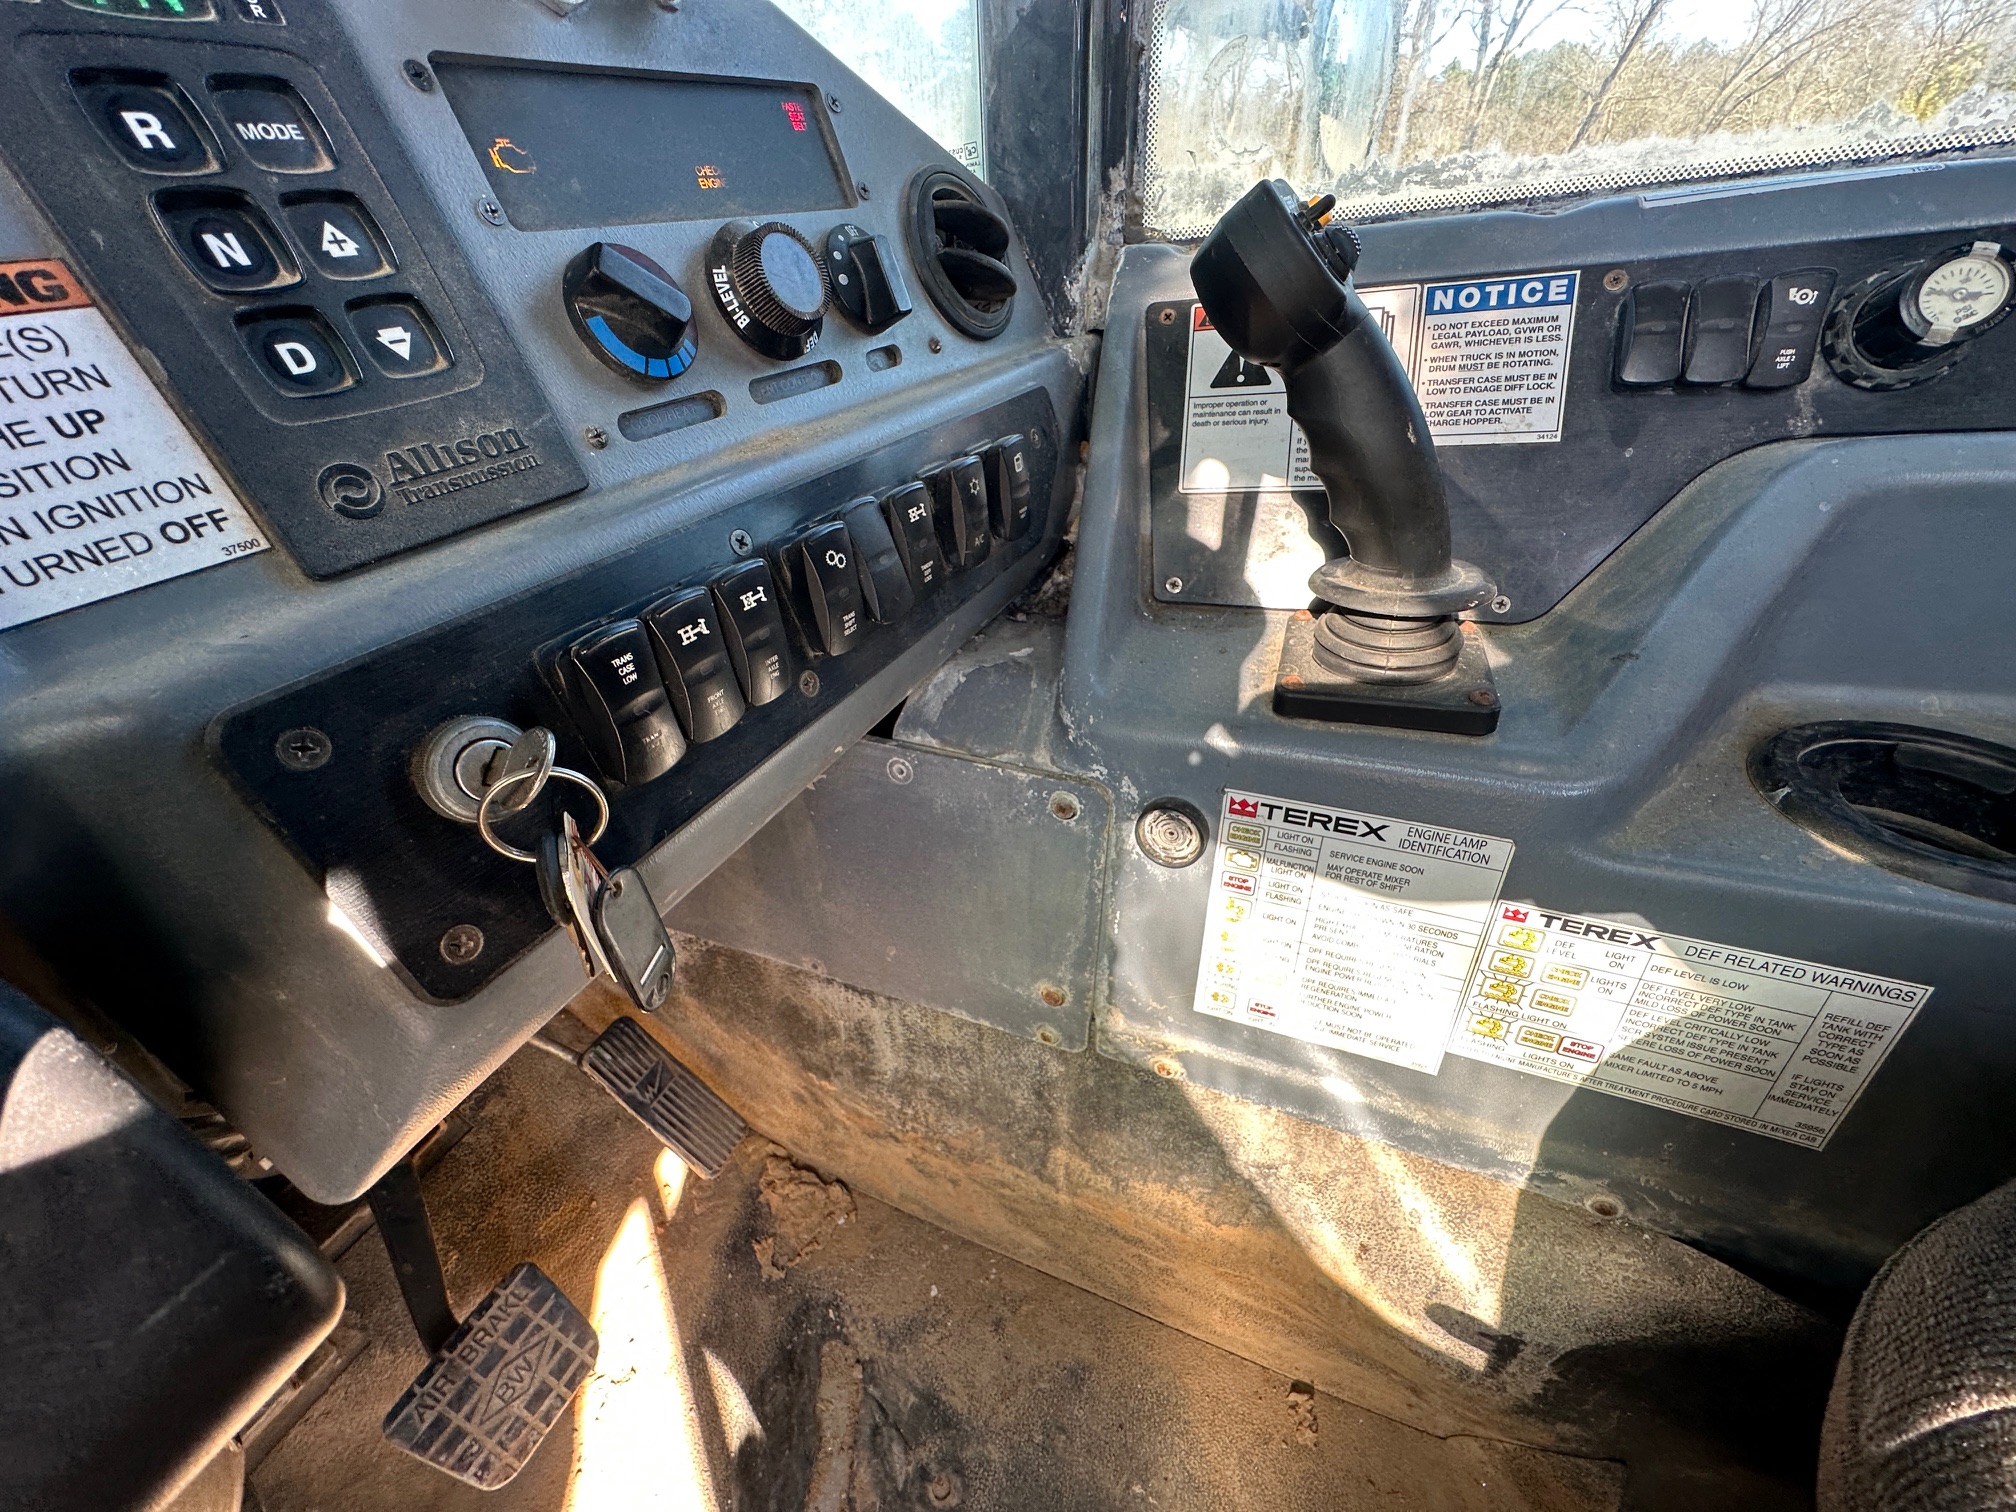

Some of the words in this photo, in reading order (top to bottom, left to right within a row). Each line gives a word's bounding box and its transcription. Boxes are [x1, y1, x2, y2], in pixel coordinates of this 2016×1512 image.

[120, 111, 176, 149] R
[236, 123, 305, 140] MODE
[201, 231, 254, 268] N
[712, 264, 751, 329] BI-LEVEL
[1433, 279, 1569, 311] NOTICE
[1433, 323, 1446, 331] DO
[1449, 322, 1469, 330] NOT
[1471, 319, 1509, 328] EXCEED
[1512, 315, 1559, 326] MAXIMUM
[1431, 341, 1462, 350] GAWR,
[1465, 337, 1521, 348] WHICHEVER
[1536, 334, 1564, 342] LESS.
[1432, 330, 1463, 340] LEGAL
[1465, 329, 1512, 338] PAYLOAD,
[1515, 326, 1544, 335] GVWR
[274, 341, 318, 376] D
[1428, 364, 1456, 372] DRUM
[1458, 362, 1485, 372] MUST
[1487, 361, 1500, 369] BE
[1502, 358, 1554, 368] ROTATING.
[1430, 355, 1457, 364] WHEN
[1460, 352, 1492, 362] TRUCK
[1506, 351, 1516, 359] IN
[1518, 349, 1559, 358] MOTION,
[1427, 376, 1475, 386] TRANSFER
[1477, 375, 1502, 384] CASE
[1504, 374, 1531, 382] MUST
[1463, 383, 1502, 393] ENGAGE
[1527, 382, 1555, 390] LOCK.
[1194, 402, 1224, 410] Improper
[1226, 400, 1258, 409] operation
[1425, 401, 1472, 409] TRANSFER
[1474, 399, 1499, 407] CASE
[1502, 398, 1528, 406] MUST
[1545, 396, 1555, 404] IN
[1446, 409, 1472, 417] GEAR
[1488, 406, 1532, 416] ACTIVATE
[1193, 409, 1236, 418] maintenance
[1222, 418, 1246, 426] serious
[1463, 417, 1503, 425] HOPPER.
[45, 408, 105, 439] UP
[385, 427, 530, 486] Allison
[32, 473, 213, 535] IGNITION
[0, 531, 154, 594] URNED
[159, 507, 231, 545] OFF
[221, 537, 261, 557] 37500
[611, 652, 634, 668] TRANS
[618, 662, 636, 677] CASE
[622, 672, 638, 686] LOW
[707, 688, 725, 704] FRONT
[1260, 802, 1391, 842] TEREX
[1277, 831, 1300, 842] LIGHT
[1407, 826, 1451, 845] ENGINE
[1453, 835, 1488, 851] LAMP
[1274, 842, 1312, 857] FLASHING
[1398, 838, 1491, 865] IDENTIFICATION
[1266, 857, 1314, 873] MALFUNCTION
[1329, 850, 1364, 864] SERVICE
[1366, 857, 1398, 870] ENGINE
[1400, 864, 1424, 876] SOON
[1325, 872, 1342, 881] FOR
[1343, 875, 1365, 885] REST
[1366, 879, 1378, 887] OF
[1380, 881, 1404, 894] SHIFT
[1327, 863, 1343, 873] MAY
[1345, 867, 1382, 880] OPERATE
[1384, 875, 1410, 886] MIXER
[1540, 913, 1661, 951] TEREX
[1650, 964, 1673, 974] DEF
[1674, 970, 1707, 983] LEVEL
[1709, 977, 1720, 985] IS
[1721, 980, 1750, 991] LOW
[1684, 946, 1722, 961] DEF
[1723, 953, 1806, 980] RELATED
[1812, 971, 1917, 1002] WARNINGS
[1821, 1022, 1853, 1034] TANK
[1853, 1029, 1884, 1041] WITH
[1824, 1013, 1862, 1028] REFILL
[1865, 1022, 1891, 1033] DEF
[1818, 1031, 1876, 1049] CORRECT
[1818, 1040, 1847, 1052] TYPE
[1848, 1047, 1865, 1056] AS
[1802, 1055, 1859, 1074] POSSIBLE
[1809, 1048, 1844, 1061] SOON
[1844, 1056, 1862, 1065] AS
[1609, 1052, 1635, 1064] SAME
[1636, 1058, 1667, 1071] FAULT
[1669, 1066, 1682, 1075] AS
[1683, 1069, 1719, 1084] ABOVE
[1603, 1060, 1635, 1074] MIXER
[1635, 1067, 1675, 1083] LIMITED
[1676, 1078, 1690, 1087] TO
[1699, 1084, 1724, 1096] MPH
[1804, 1076, 1845, 1091] LIGHTS
[1784, 1090, 1833, 1107] SERVICE
[1790, 1082, 1817, 1093] STAY
[1819, 1090, 1837, 1098] ON
[1767, 1094, 1839, 1117] IMMEDIATELY
[1795, 1121, 1826, 1134] 35956
[412, 1373, 457, 1424] AIR
[458, 1288, 530, 1366] BRAKE
[495, 1354, 536, 1405] BW
